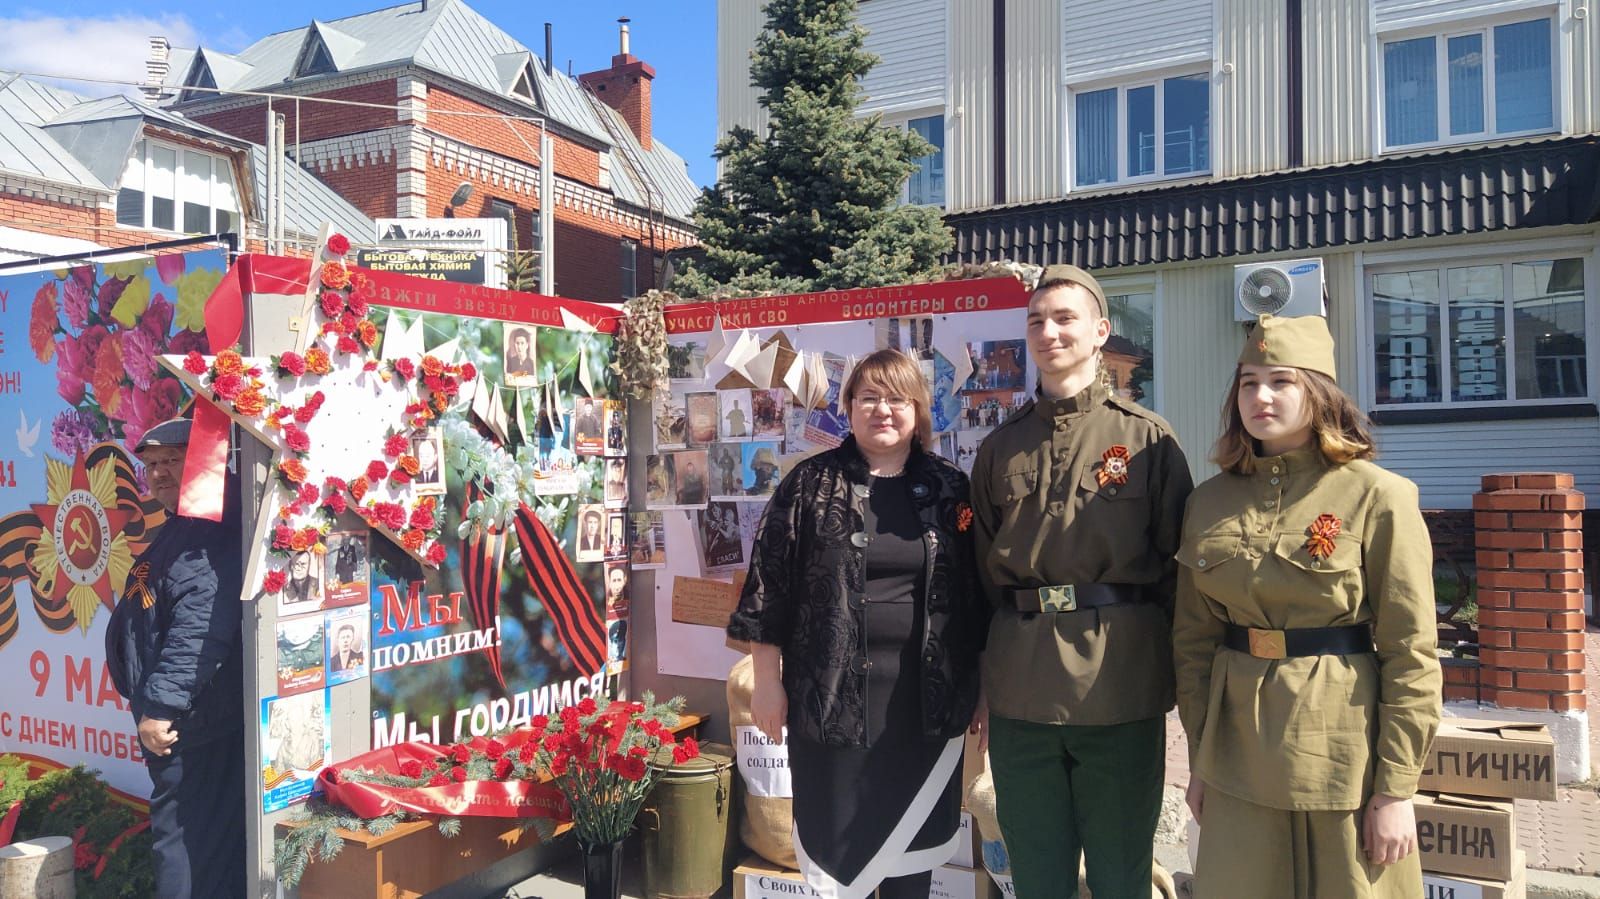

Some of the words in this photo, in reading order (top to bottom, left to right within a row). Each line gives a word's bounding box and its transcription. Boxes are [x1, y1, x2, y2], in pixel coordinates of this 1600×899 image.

[370, 262, 427, 271] БЫТОВАЯ
[430, 262, 471, 271] ХИМИЯ
[714, 297, 789, 312] СТУДЕНТЫ
[842, 297, 945, 318] ВОЛОНТЕРЫ
[954, 294, 989, 310] СВО
[668, 311, 751, 331] УЧАСТИКИ
[758, 309, 788, 324] СВО
[378, 580, 465, 636] Мы
[29, 649, 51, 697] 9
[64, 654, 132, 712] МА
[0, 711, 13, 737] С
[18, 715, 77, 750] ДНЕМ
[83, 726, 148, 767] ПОБЕ
[758, 876, 806, 895] Своих
